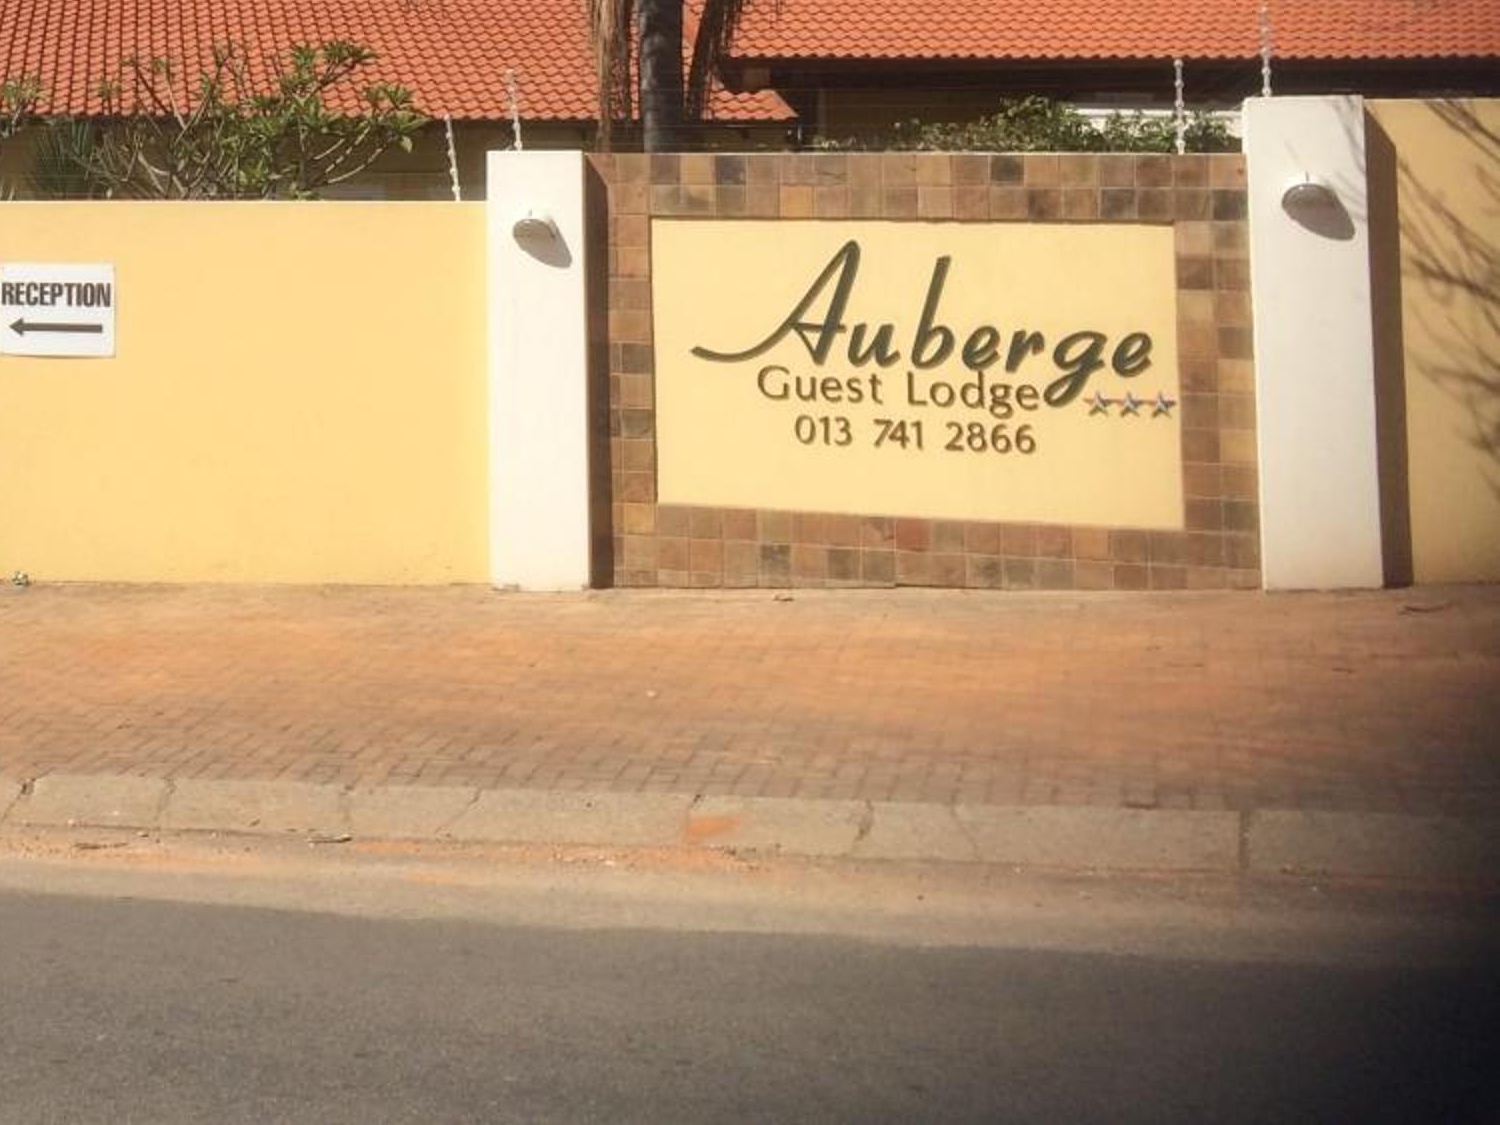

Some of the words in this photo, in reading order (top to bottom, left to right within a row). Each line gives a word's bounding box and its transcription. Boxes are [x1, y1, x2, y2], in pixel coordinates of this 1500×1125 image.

[1, 282, 111, 307] RECEPTION
[690, 239, 1153, 407] Auberge
[757, 365, 884, 404] Guest
[907, 370, 1040, 418] Lodge
[795, 415, 852, 448] 013
[874, 418, 924, 450] 741
[945, 422, 1038, 455] 2866
